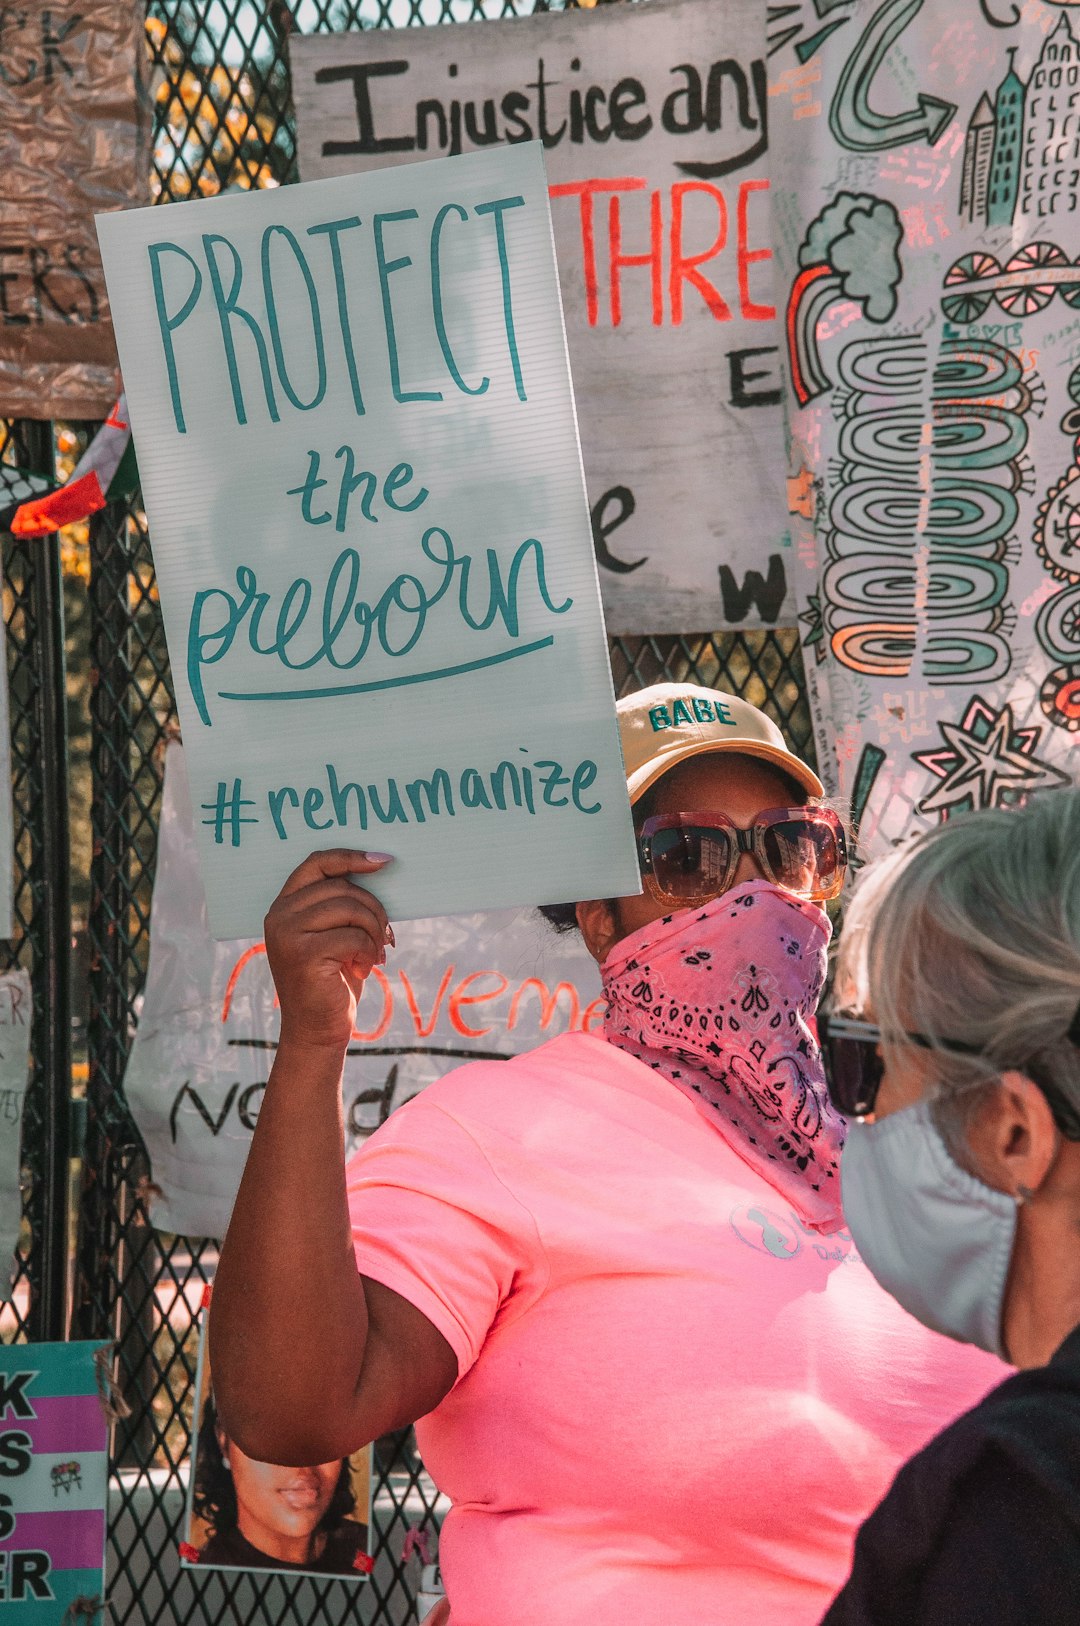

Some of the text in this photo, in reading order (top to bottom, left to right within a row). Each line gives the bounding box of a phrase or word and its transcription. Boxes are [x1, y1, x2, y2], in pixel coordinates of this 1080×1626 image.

[315, 57, 653, 157] Injustice
[661, 58, 769, 180] any
[147, 195, 528, 433] PROTECT
[287, 445, 429, 532] the
[187, 527, 573, 726] preborn
[648, 697, 737, 732] BABE
[201, 748, 602, 847] #rehumanize
